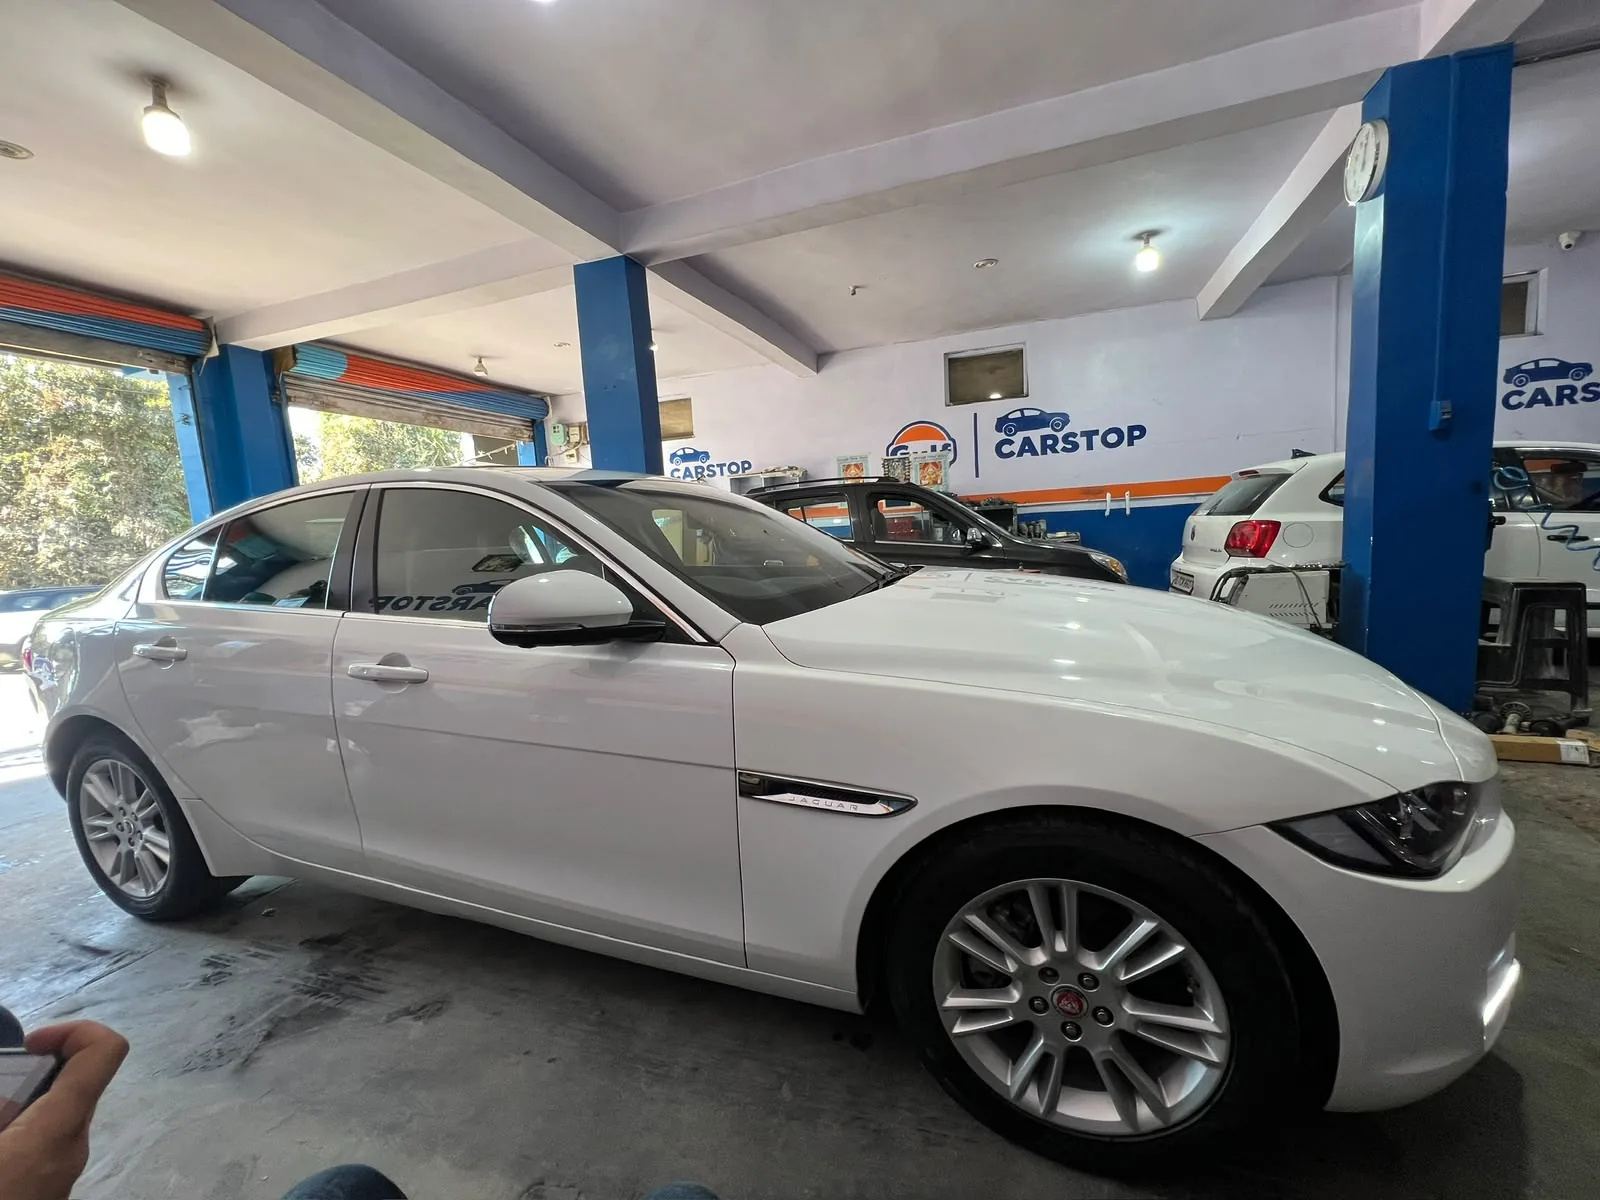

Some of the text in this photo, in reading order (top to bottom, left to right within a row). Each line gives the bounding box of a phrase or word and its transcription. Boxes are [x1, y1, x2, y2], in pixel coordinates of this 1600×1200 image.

[1502, 382, 1600, 410] CARS
[994, 424, 1147, 459] CARSTOP
[671, 460, 752, 480] CARSTOP
[788, 796, 859, 811] JAGUAR
